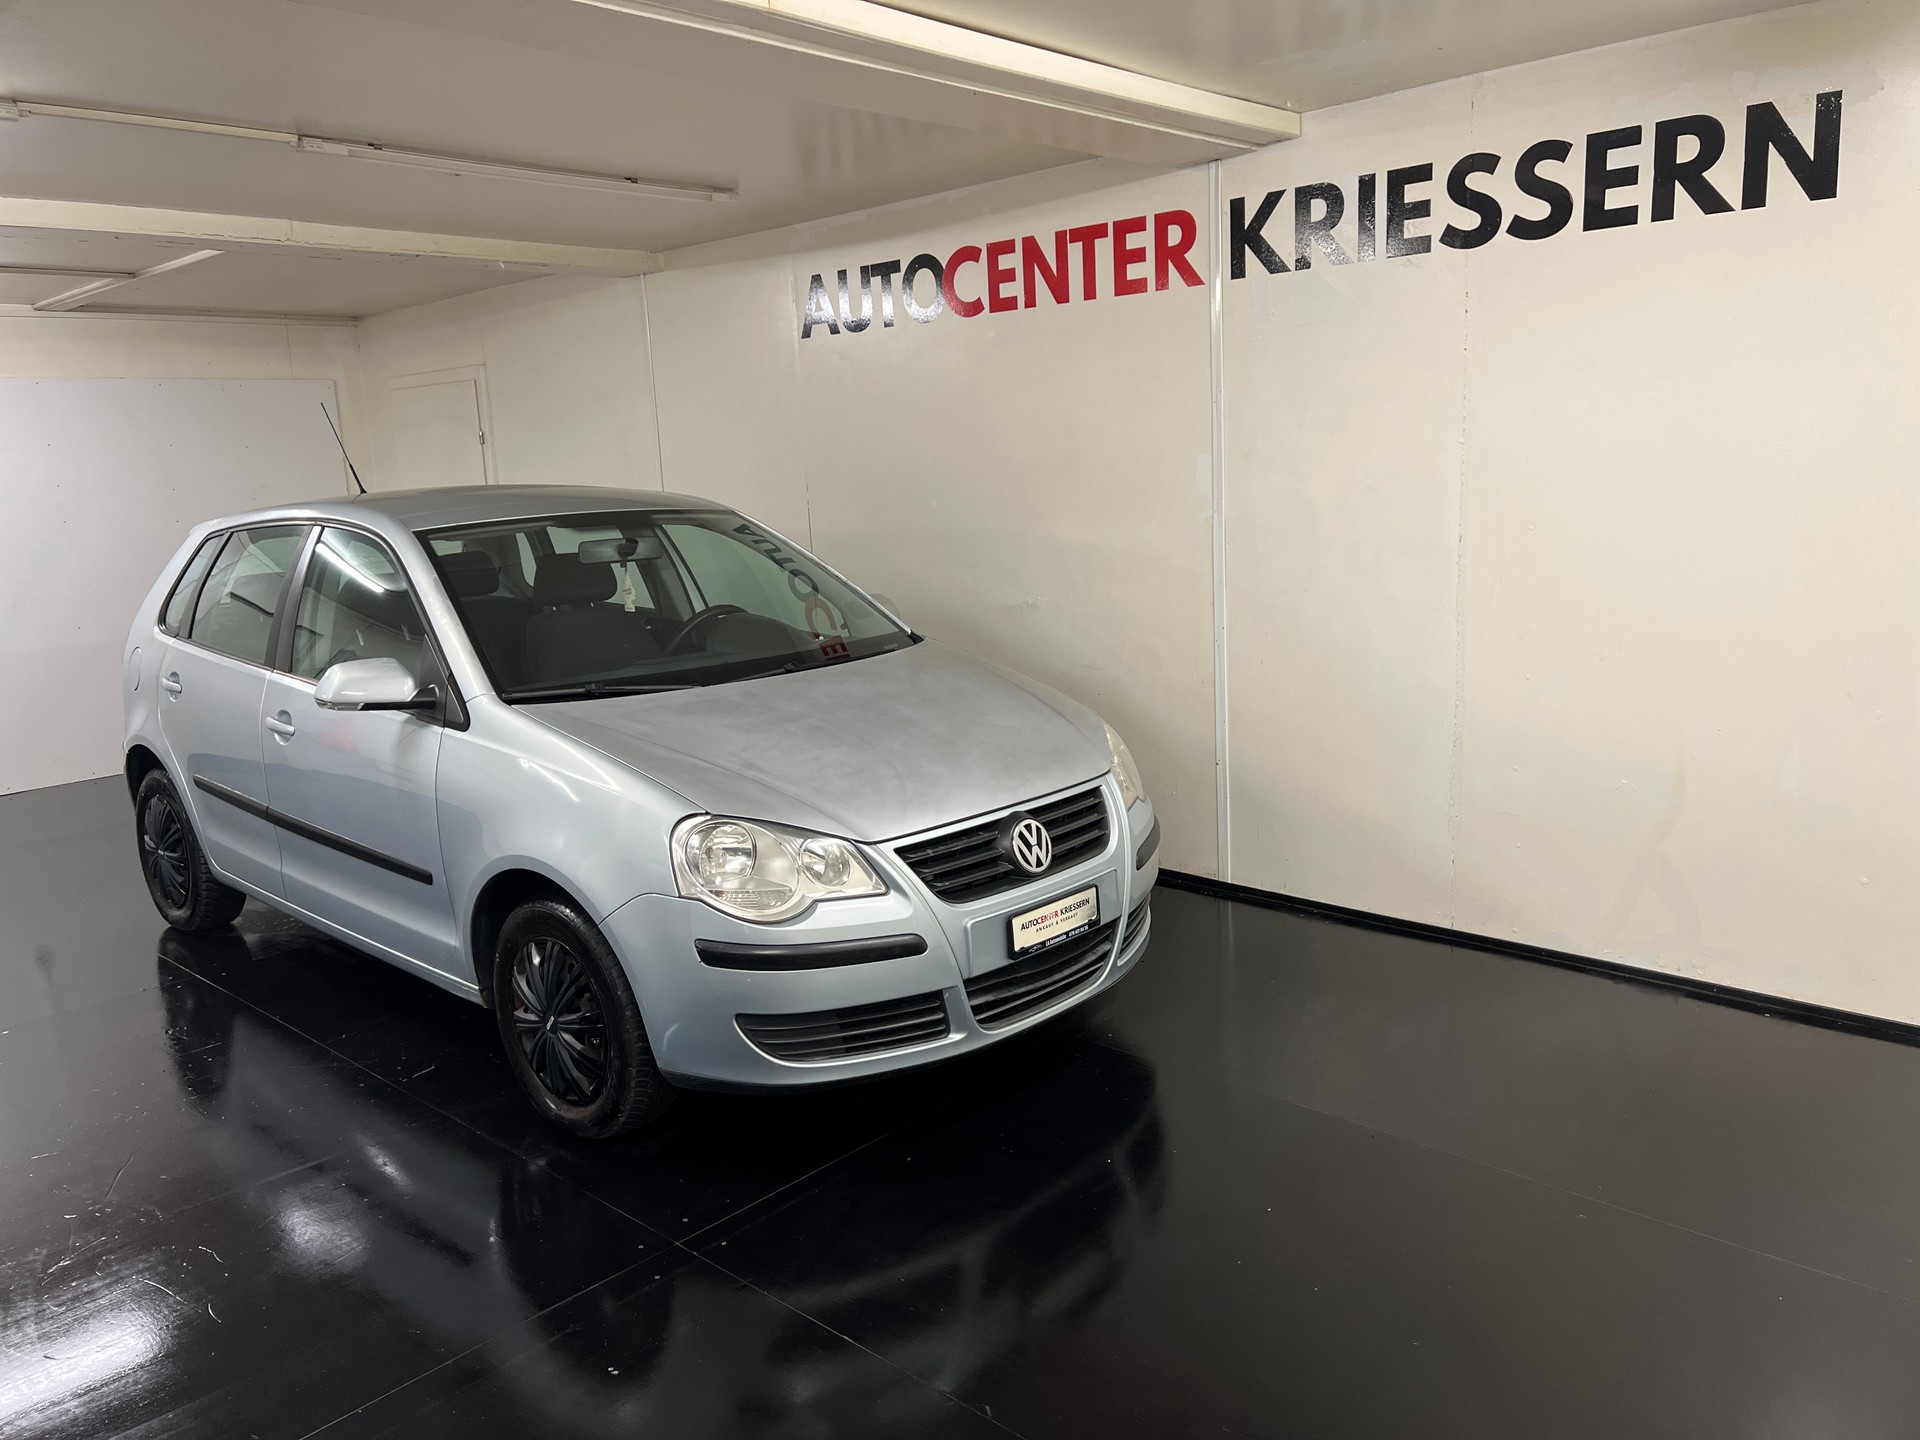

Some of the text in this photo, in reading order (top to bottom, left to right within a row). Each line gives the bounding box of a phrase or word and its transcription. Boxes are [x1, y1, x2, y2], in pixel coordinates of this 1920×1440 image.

[801, 89, 1843, 340] AUTOCENTER KRIESSERN
[1060, 897, 1090, 916] KRIESSERN
